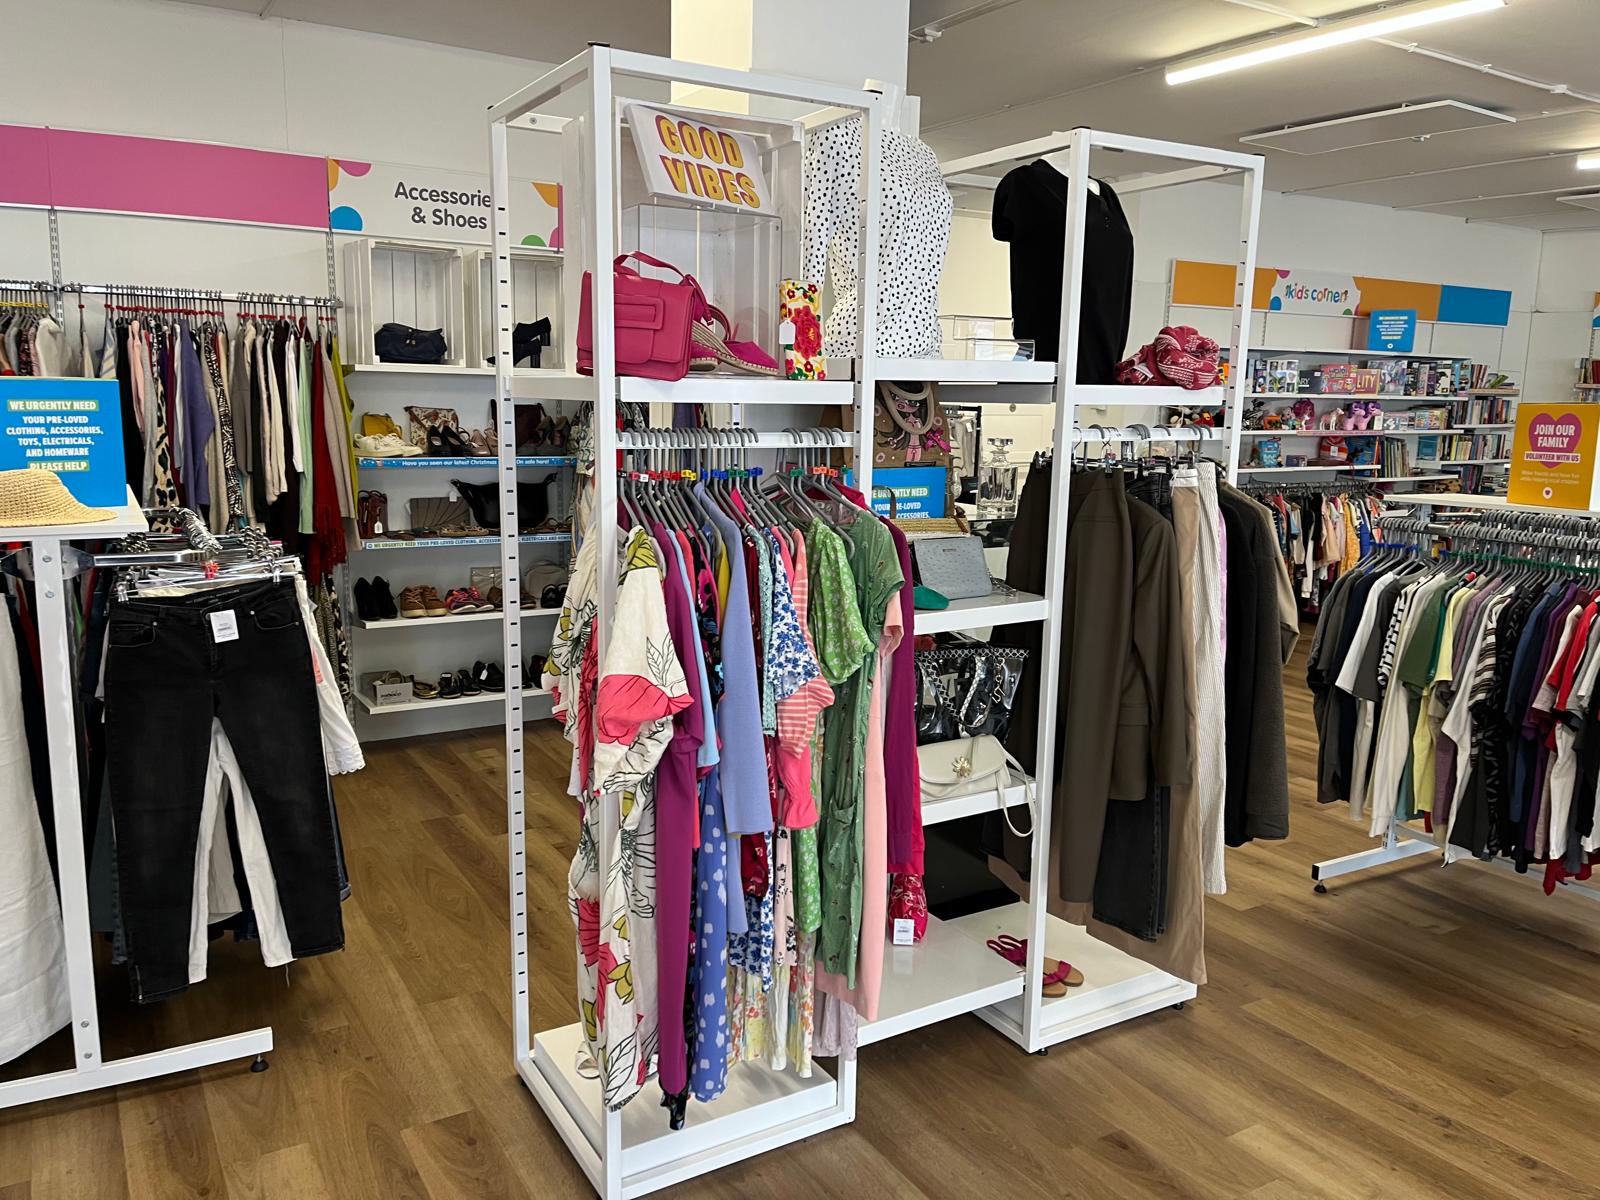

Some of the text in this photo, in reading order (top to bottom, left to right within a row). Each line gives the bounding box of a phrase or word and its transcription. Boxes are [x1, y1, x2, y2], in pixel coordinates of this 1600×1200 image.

[655, 115, 744, 168] GOOD
[659, 155, 761, 208] VIBES
[394, 181, 491, 208] Accessorie
[411, 206, 487, 230] & Shoes
[1311, 287, 1349, 303] corner
[9, 400, 97, 410] WE URGENTLY NEED
[22, 415, 89, 424] YOUR PRE-LOVED
[6, 426, 104, 436] CLOTHING, ACCESSORIES,
[1534, 424, 1576, 436] JOIN OUR
[17, 436, 95, 447] TOYS, ELECTRICALS,
[1537, 436, 1570, 448] FAMILY
[26, 447, 89, 457] AND HOMEWARE
[64, 461, 88, 470] HELP
[911, 487, 928, 497] NEED
[896, 502, 922, 510] RE-LOVED
